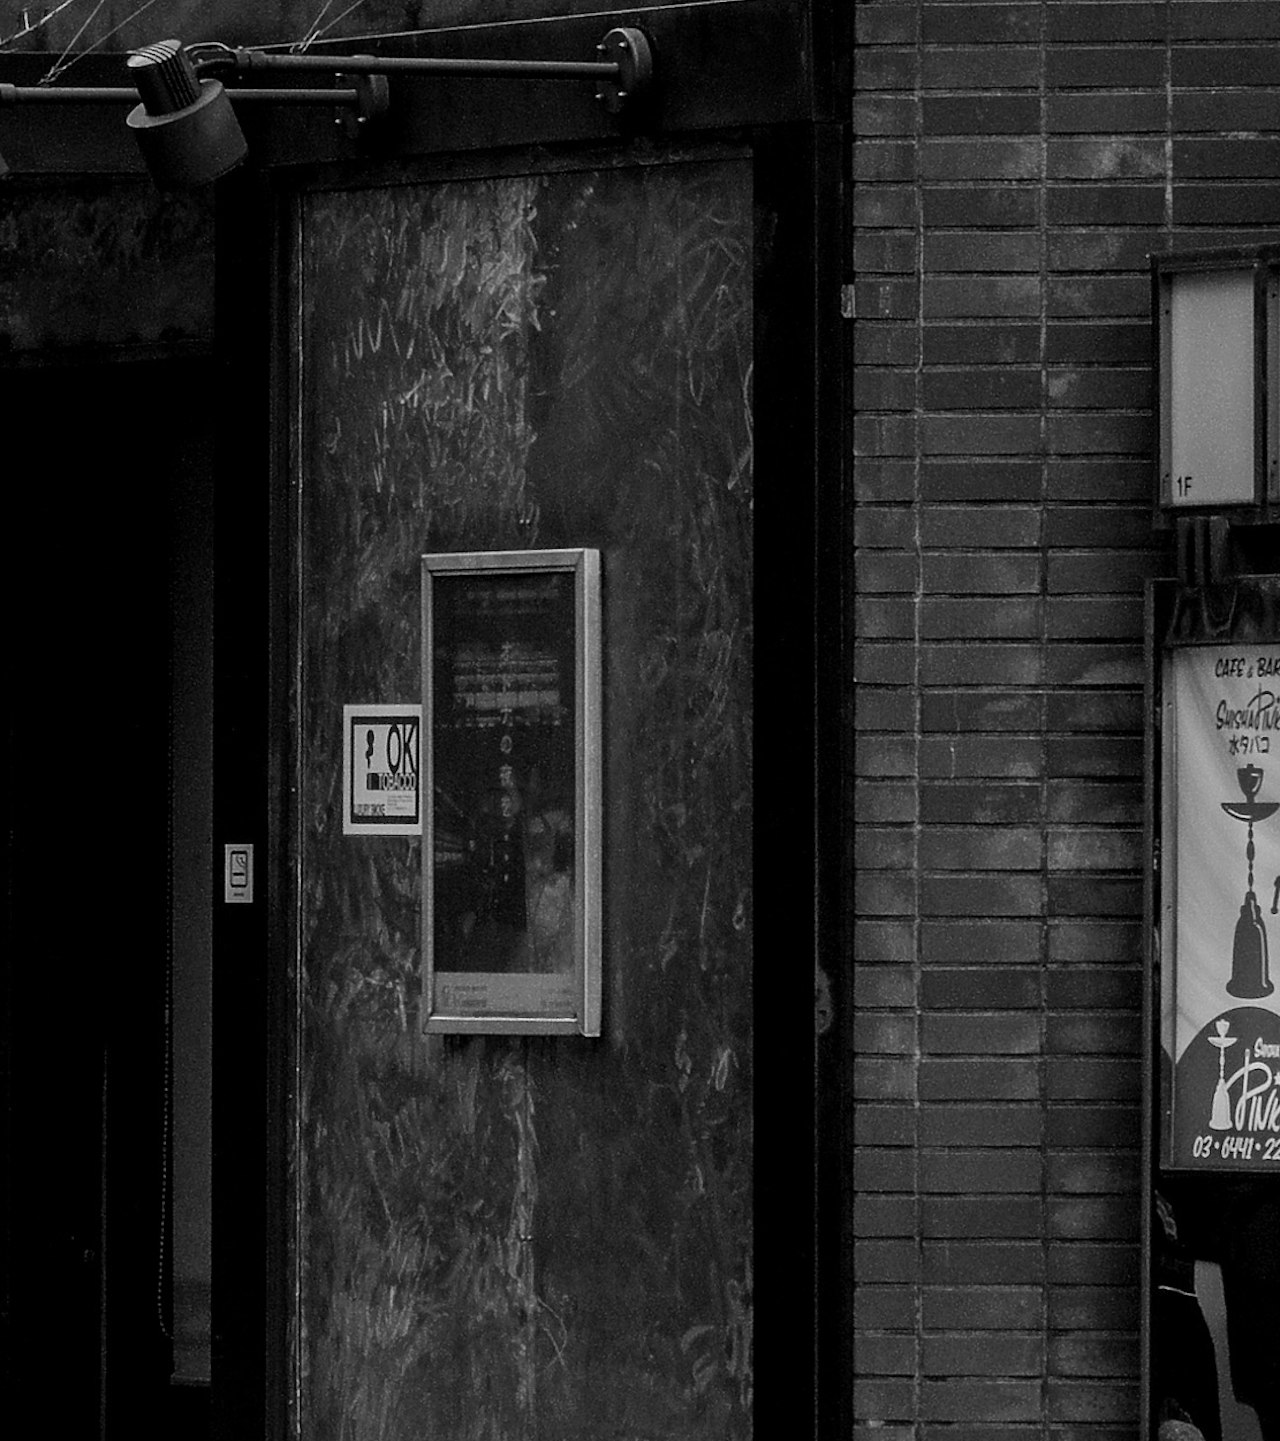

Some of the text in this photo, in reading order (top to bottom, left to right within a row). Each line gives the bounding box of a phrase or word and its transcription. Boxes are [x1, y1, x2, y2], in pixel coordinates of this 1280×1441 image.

[1177, 476, 1193, 497] 1F
[1215, 657, 1246, 678] CAFE
[387, 723, 417, 774] OK
